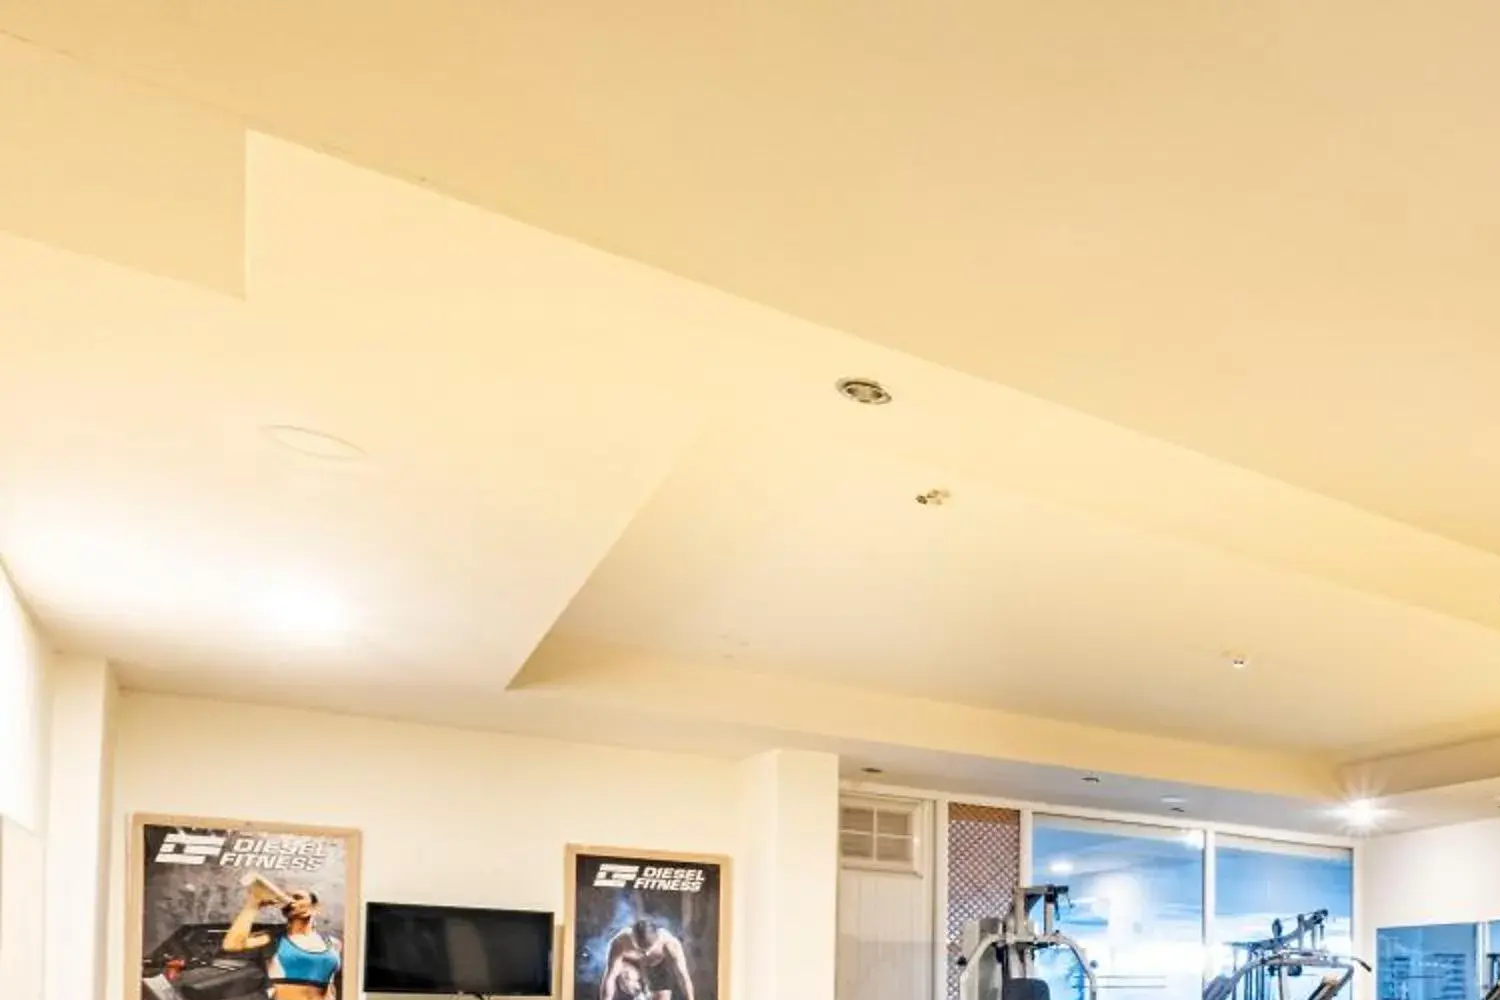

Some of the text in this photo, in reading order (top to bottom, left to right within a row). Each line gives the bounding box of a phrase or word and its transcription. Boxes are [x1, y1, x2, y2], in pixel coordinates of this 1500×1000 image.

[233, 838, 328, 857] DIESEL
[219, 853, 326, 872] FITNESS
[642, 866, 705, 881] DIESEL
[633, 878, 703, 892] FITNESS
